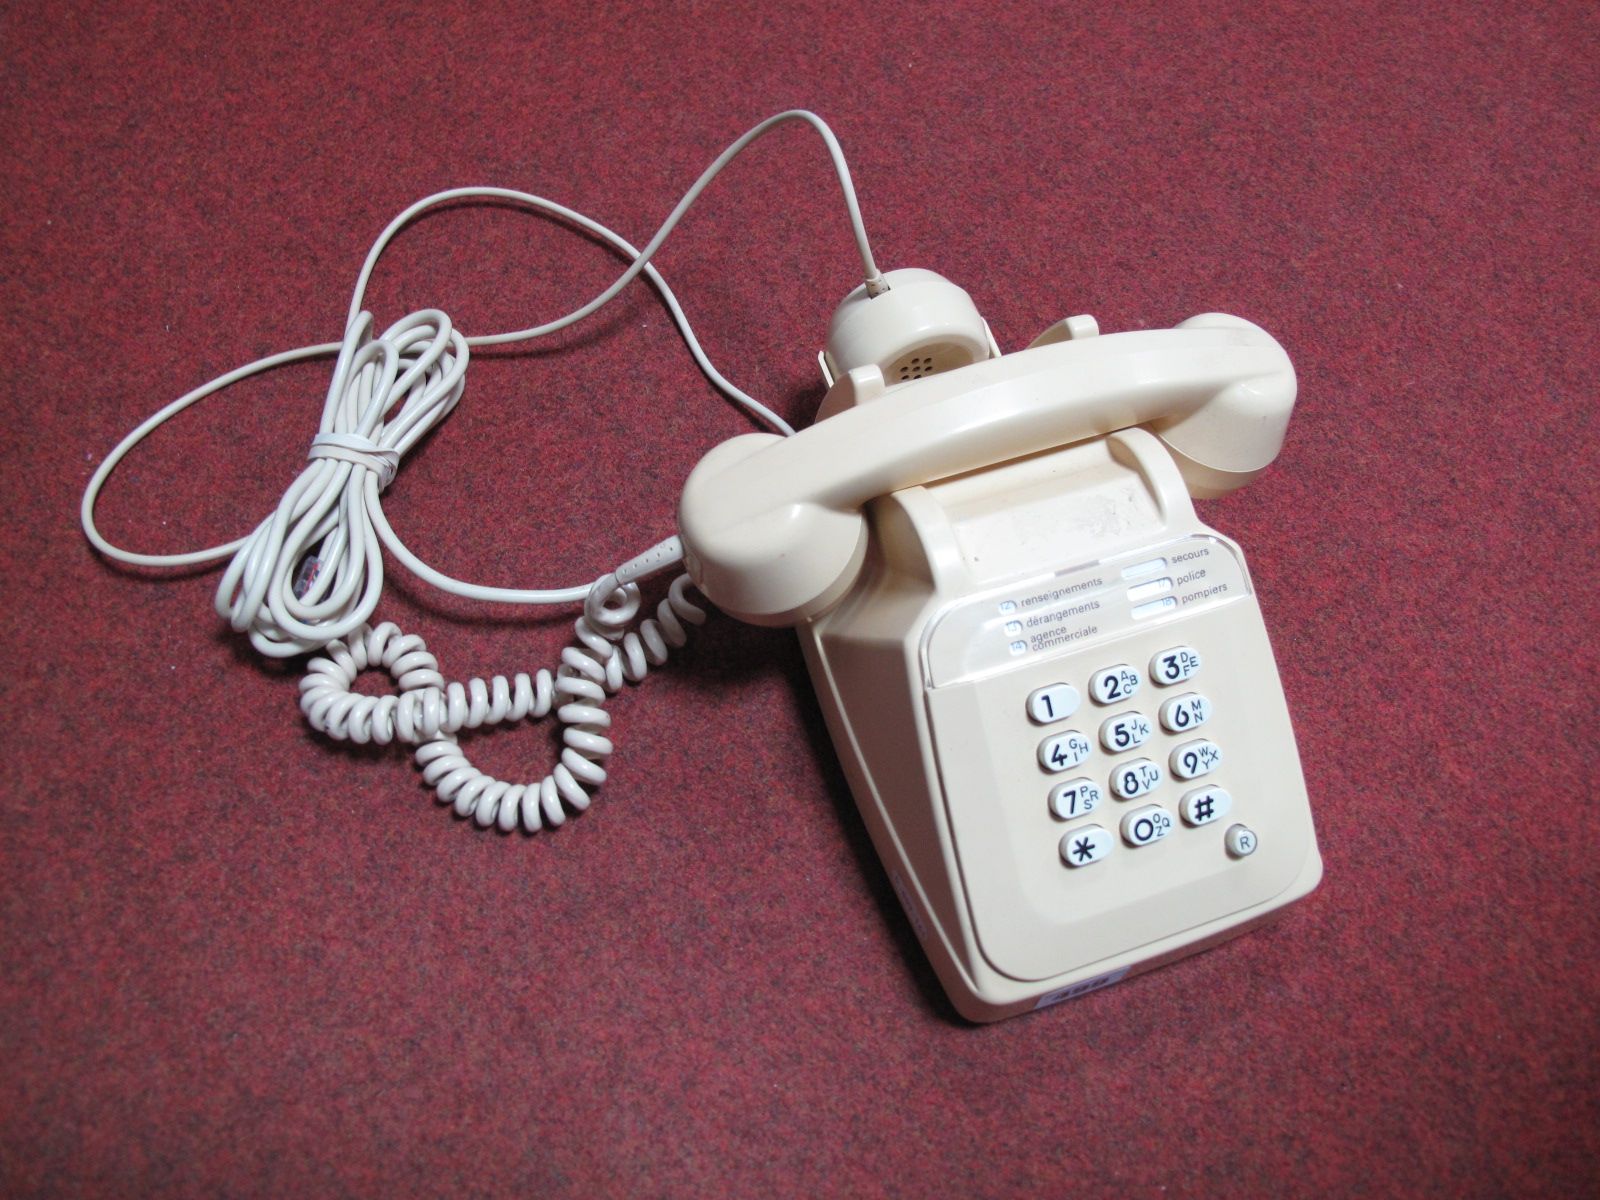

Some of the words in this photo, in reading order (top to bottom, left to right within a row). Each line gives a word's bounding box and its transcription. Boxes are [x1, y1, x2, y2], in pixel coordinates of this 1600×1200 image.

[1171, 548, 1209, 564] secours
[1176, 569, 1207, 586] police
[1020, 577, 1103, 607] renseignements
[1181, 583, 1227, 605] pompiers
[1026, 601, 1100, 628] dérangements
[1030, 626, 1067, 643] agence
[1032, 625, 1098, 651] commerciale
[1163, 655, 1180, 679] 3
[1104, 675, 1121, 699] 2
[1041, 695, 1054, 717] 1
[1174, 704, 1189, 727] 6
[1114, 723, 1130, 747] 5
[1051, 744, 1068, 766] 4
[1183, 751, 1198, 775] 9
[1124, 771, 1139, 795] 8
[1063, 790, 1076, 814] 7
[1239, 835, 1251, 849] R
